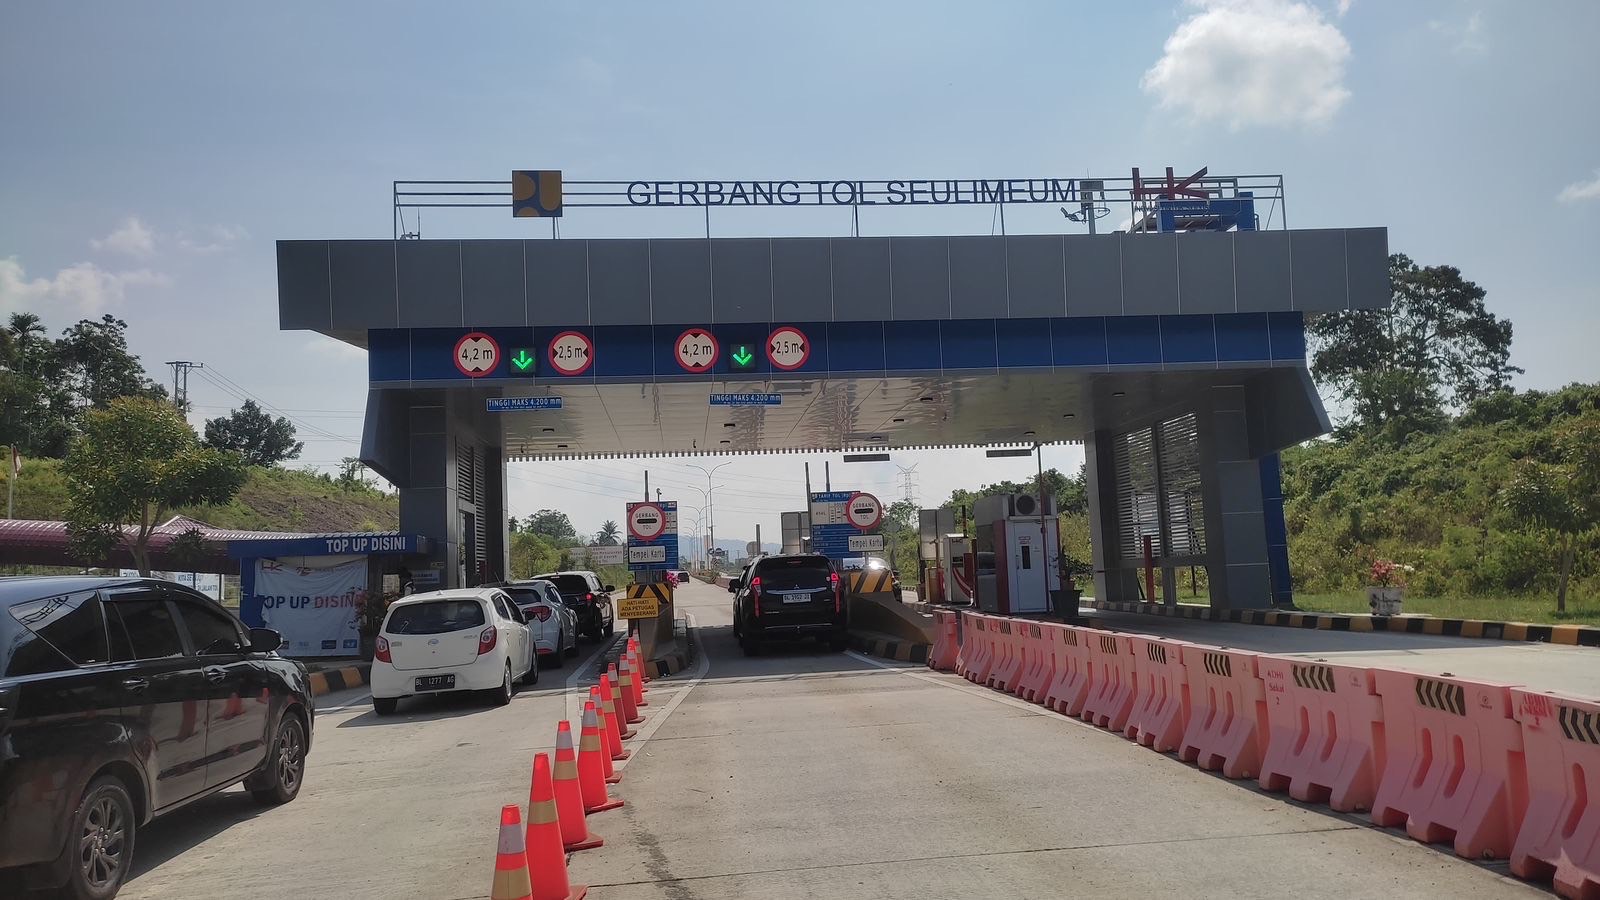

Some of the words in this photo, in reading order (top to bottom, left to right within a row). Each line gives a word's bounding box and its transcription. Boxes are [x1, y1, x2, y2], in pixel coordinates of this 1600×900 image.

[627, 181, 801, 206] GERBANG
[810, 180, 876, 205] TOL
[887, 178, 1076, 204] SEULIMEUM
[461, 348, 479, 362] 4,2
[482, 349, 493, 360] m
[558, 346, 572, 360] 2,5
[574, 347, 583, 358] m
[682, 344, 699, 357] 4,2
[702, 345, 712, 355] m
[776, 341, 790, 356] 2,5
[791, 342, 800, 353] m
[488, 399, 510, 407] TINGGI
[326, 539, 349, 553] TOP
[352, 538, 368, 551] UP
[371, 537, 406, 551] DISINI
[630, 549, 649, 560] Tempel
[290, 595, 310, 609] UP
[415, 678, 422, 686] BL
[428, 677, 442, 685] 1277
